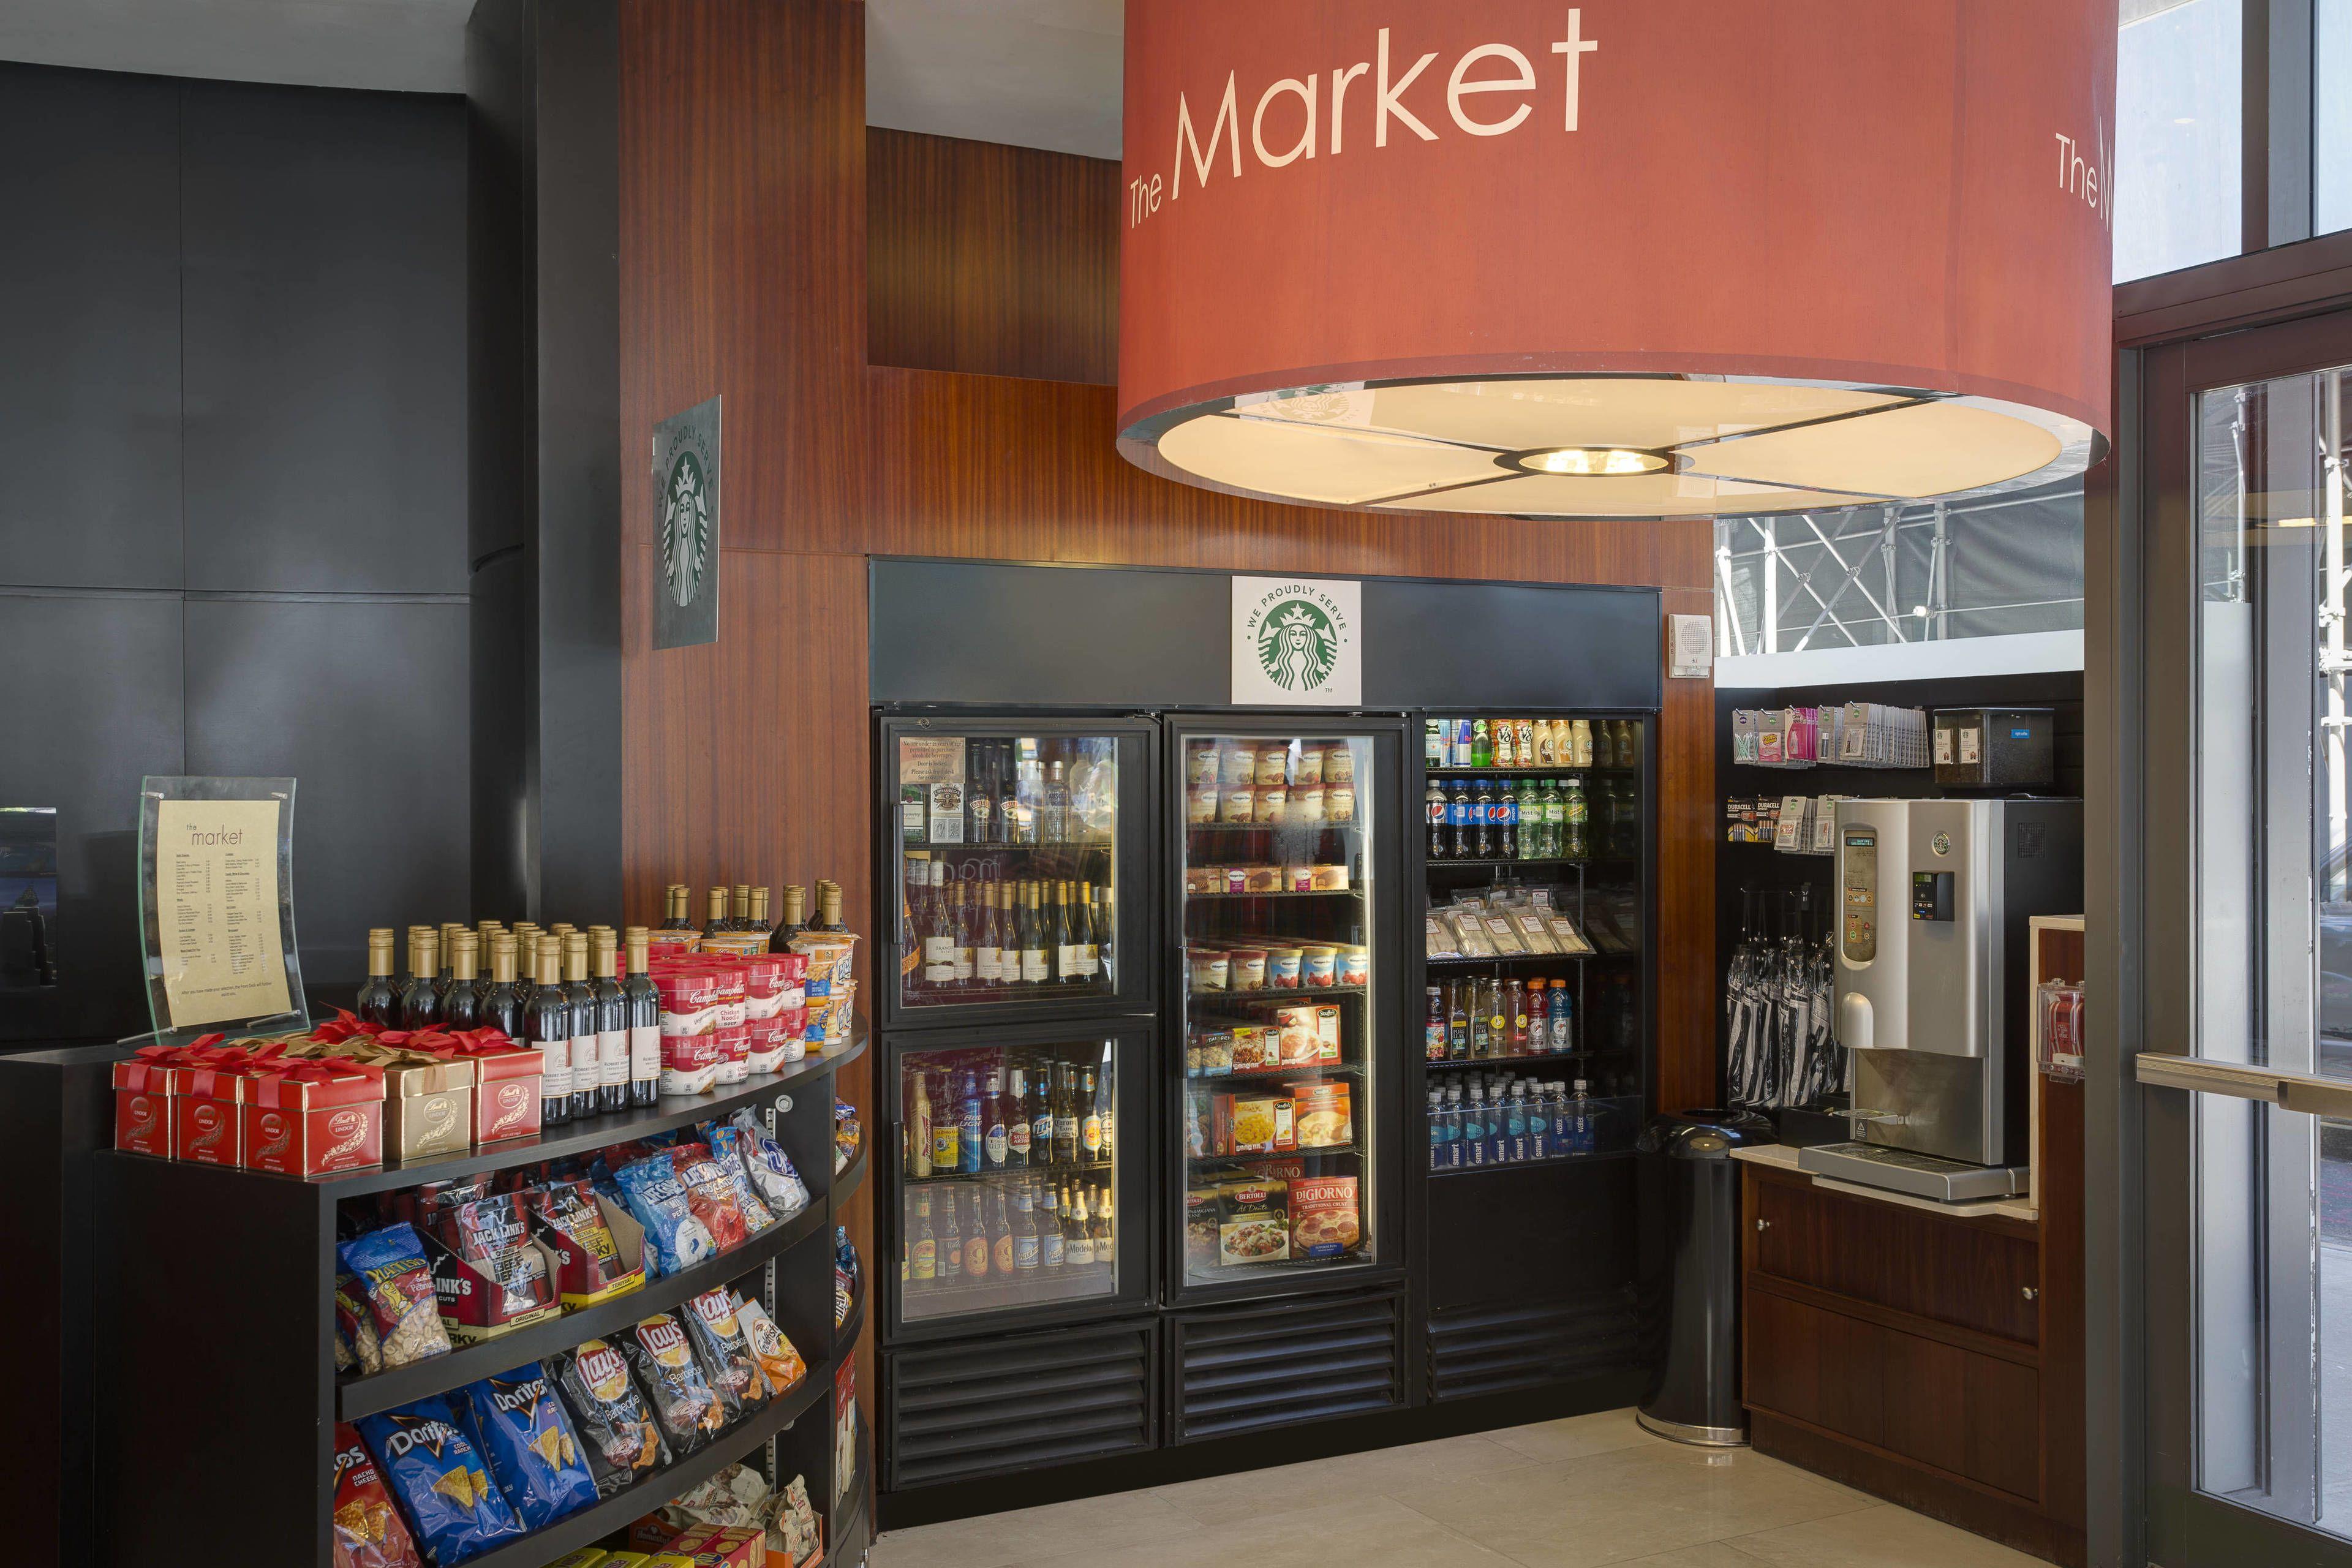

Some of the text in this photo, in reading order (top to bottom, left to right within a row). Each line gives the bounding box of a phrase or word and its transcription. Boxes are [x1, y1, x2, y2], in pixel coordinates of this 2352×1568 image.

[1131, 8, 1598, 229] The Market
[2056, 132, 2097, 208] The
[665, 423, 696, 471] PROUDLY
[697, 432, 714, 491] SERVE
[1247, 584, 1346, 630] WE PROUDLY SERVE
[186, 823, 197, 832] the
[192, 824, 244, 846] market
[335, 1123, 354, 1133] LINDOR
[1238, 1192, 1267, 1200] BERTOLLI
[552, 1205, 599, 1229] JACK LINK'S
[472, 1220, 526, 1246] JACK LINK'S
[1069, 1242, 1092, 1254] Modelo
[365, 1257, 426, 1284] PLANTERS
[435, 1277, 472, 1296] INK'S
[611, 1278, 632, 1289] TERIYAKI
[514, 1310, 541, 1324] ORIGINAL
[693, 1284, 733, 1325] Lay's
[639, 1319, 684, 1357] Lay's
[579, 1346, 620, 1390] Lay's
[492, 1379, 548, 1412] Doritos
[604, 1393, 641, 1422] Barbecue
[388, 1419, 459, 1457] Doritos
[453, 1446, 472, 1455] RANCH
[352, 1469, 375, 1482] NACHO
[353, 1474, 379, 1487] CHEESE
